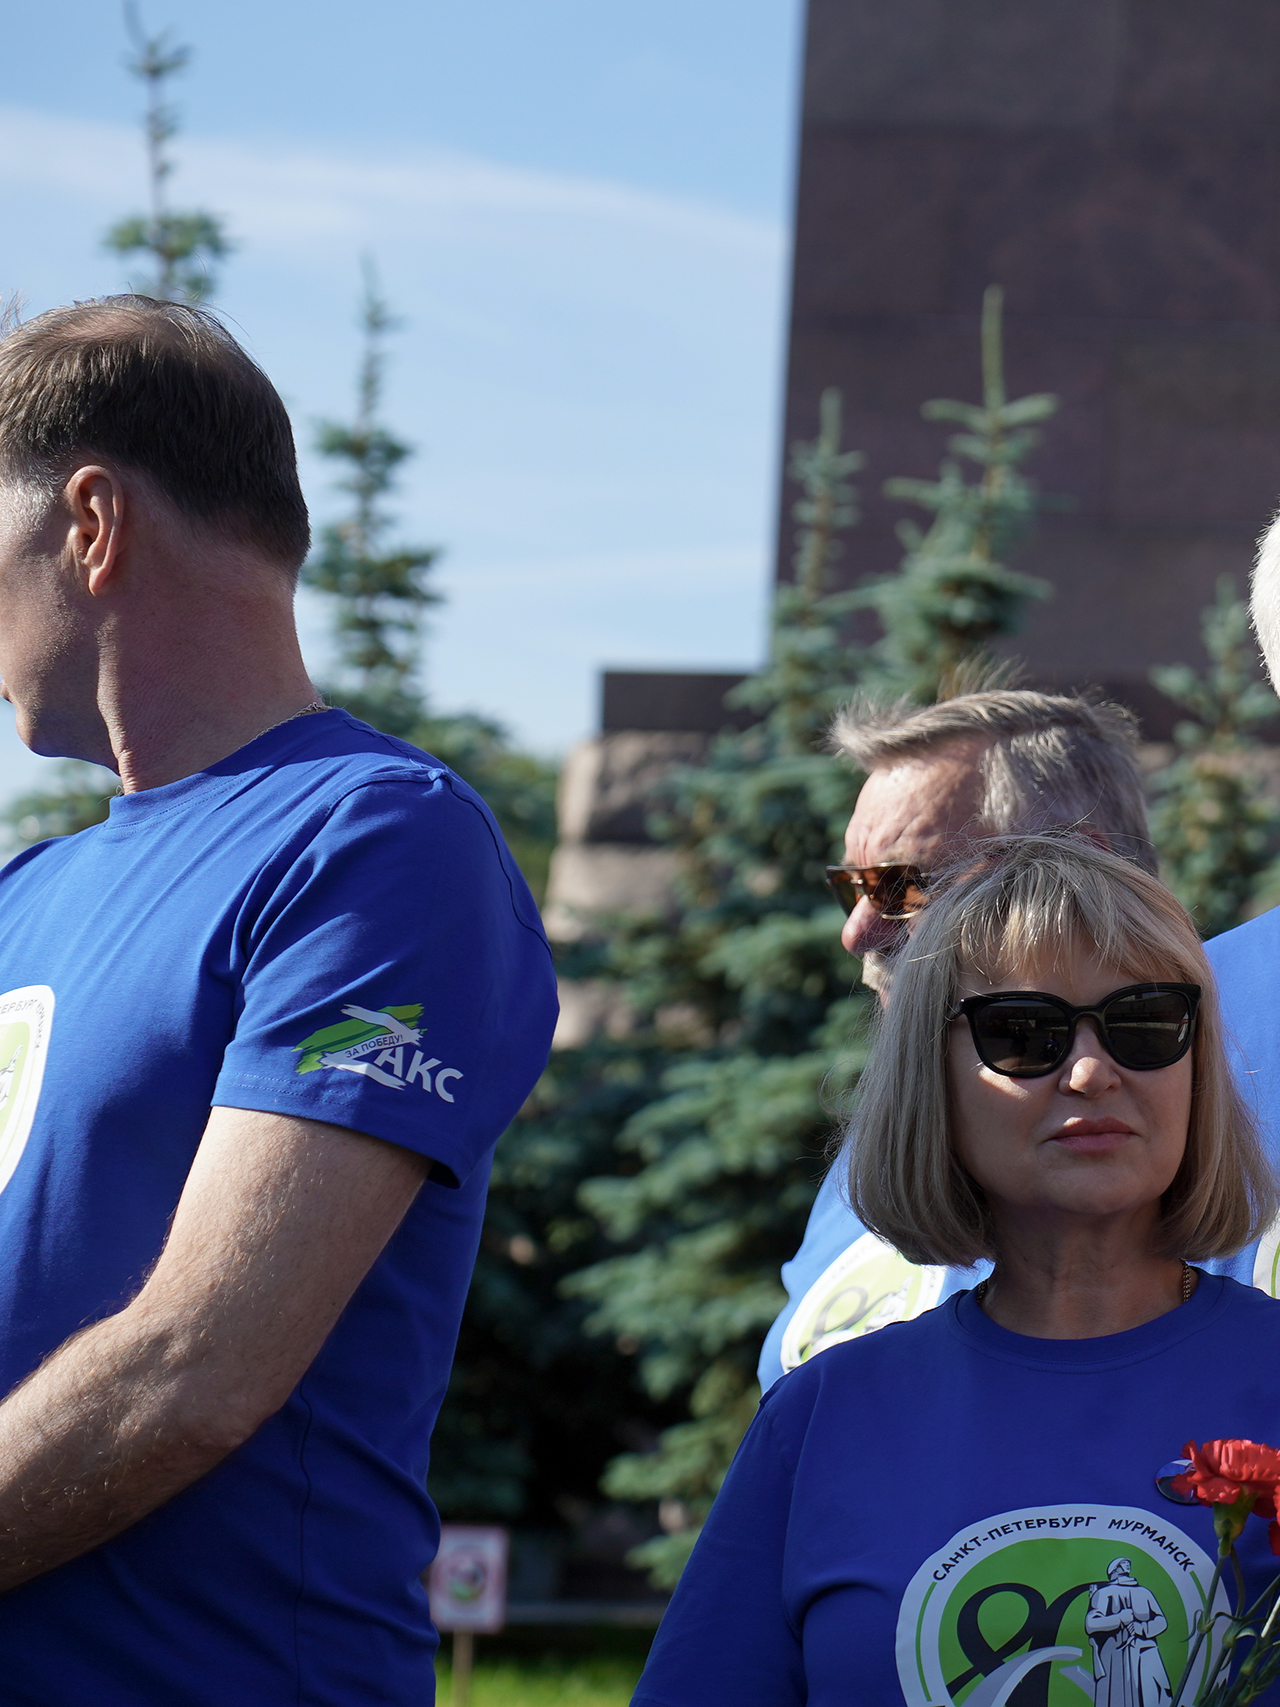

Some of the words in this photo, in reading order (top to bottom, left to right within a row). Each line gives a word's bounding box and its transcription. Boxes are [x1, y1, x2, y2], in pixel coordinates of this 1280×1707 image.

[0, 999, 38, 1015] ЕРБУРГ
[344, 1048, 360, 1059] ЗА
[361, 1034, 404, 1052] ПОБЕДУ!
[932, 1515, 1097, 1582] САНКТ-ПЕТЕРБУРГ
[1107, 1517, 1196, 1573] МУРМАНСК
